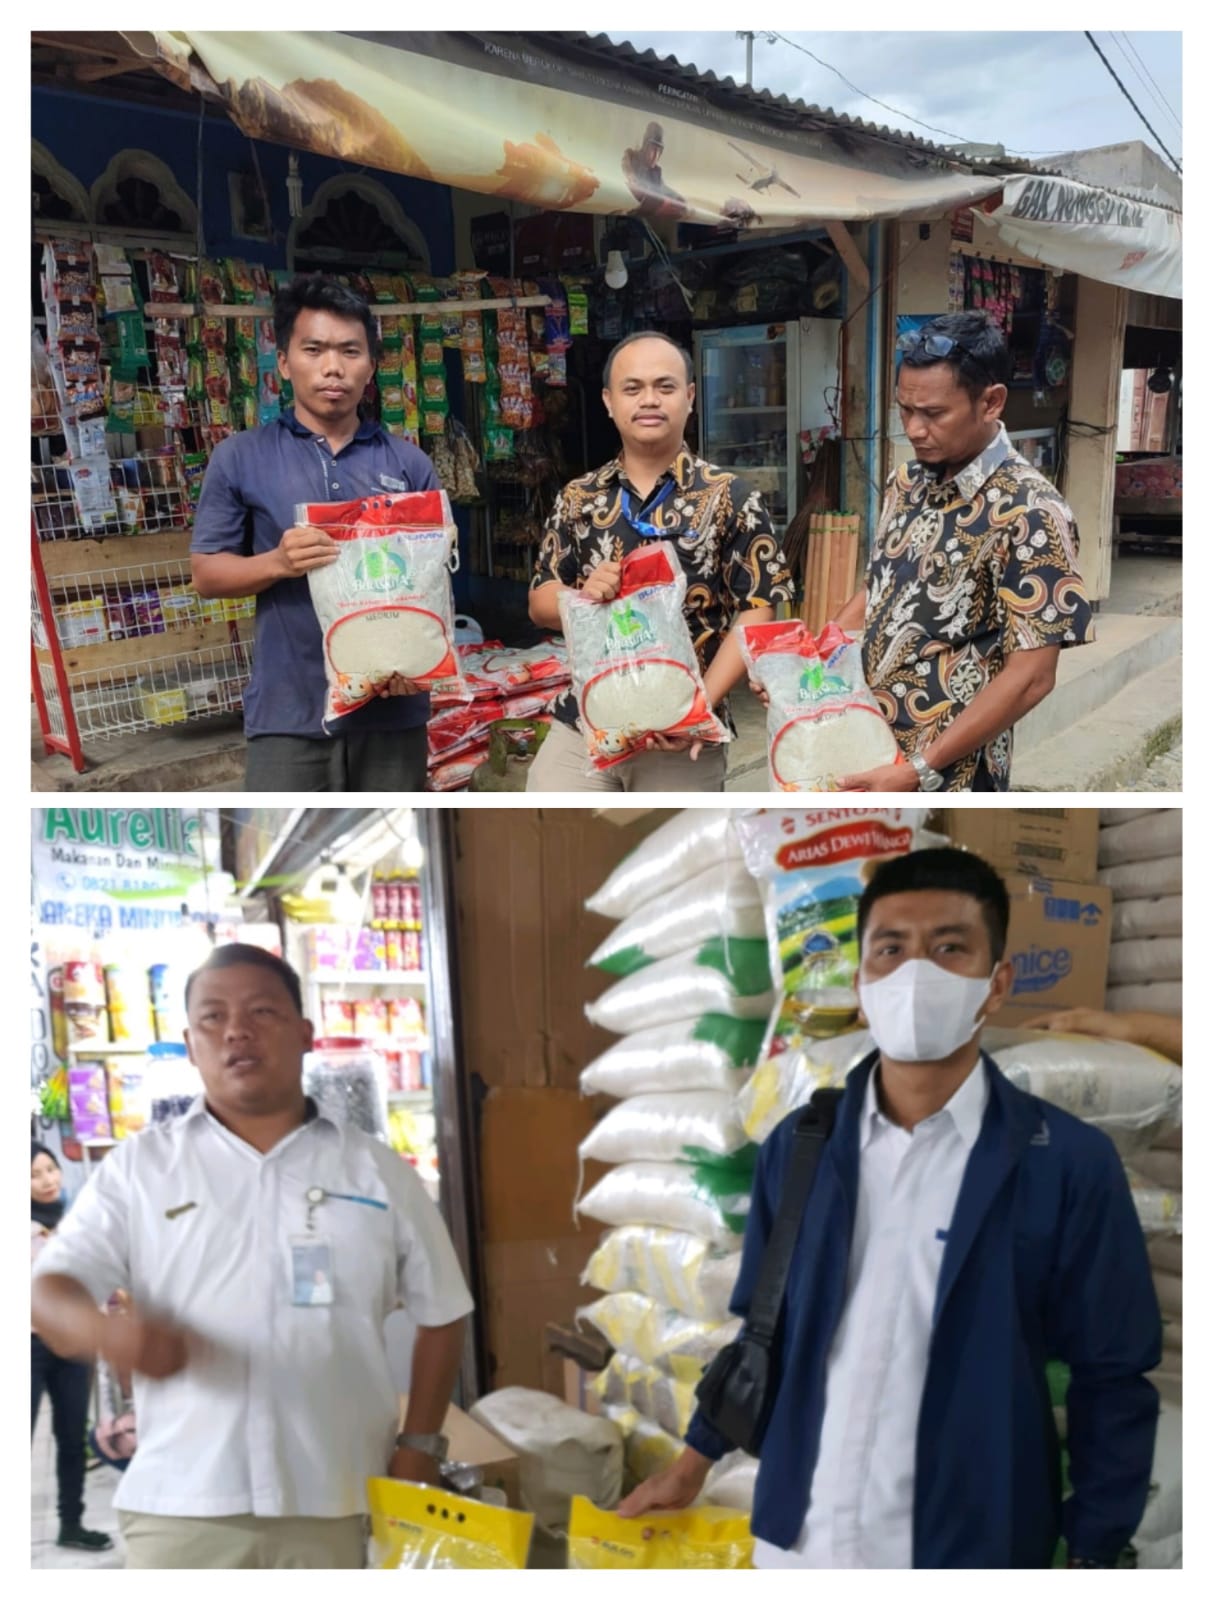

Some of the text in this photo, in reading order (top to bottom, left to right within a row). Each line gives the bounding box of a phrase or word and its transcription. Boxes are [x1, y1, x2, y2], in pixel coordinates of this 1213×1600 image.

[1012, 179, 1054, 221] GAK
[44, 808, 203, 854] Aurelia
[115, 852, 142, 870] Dan
[787, 842, 829, 864] ARIAS
